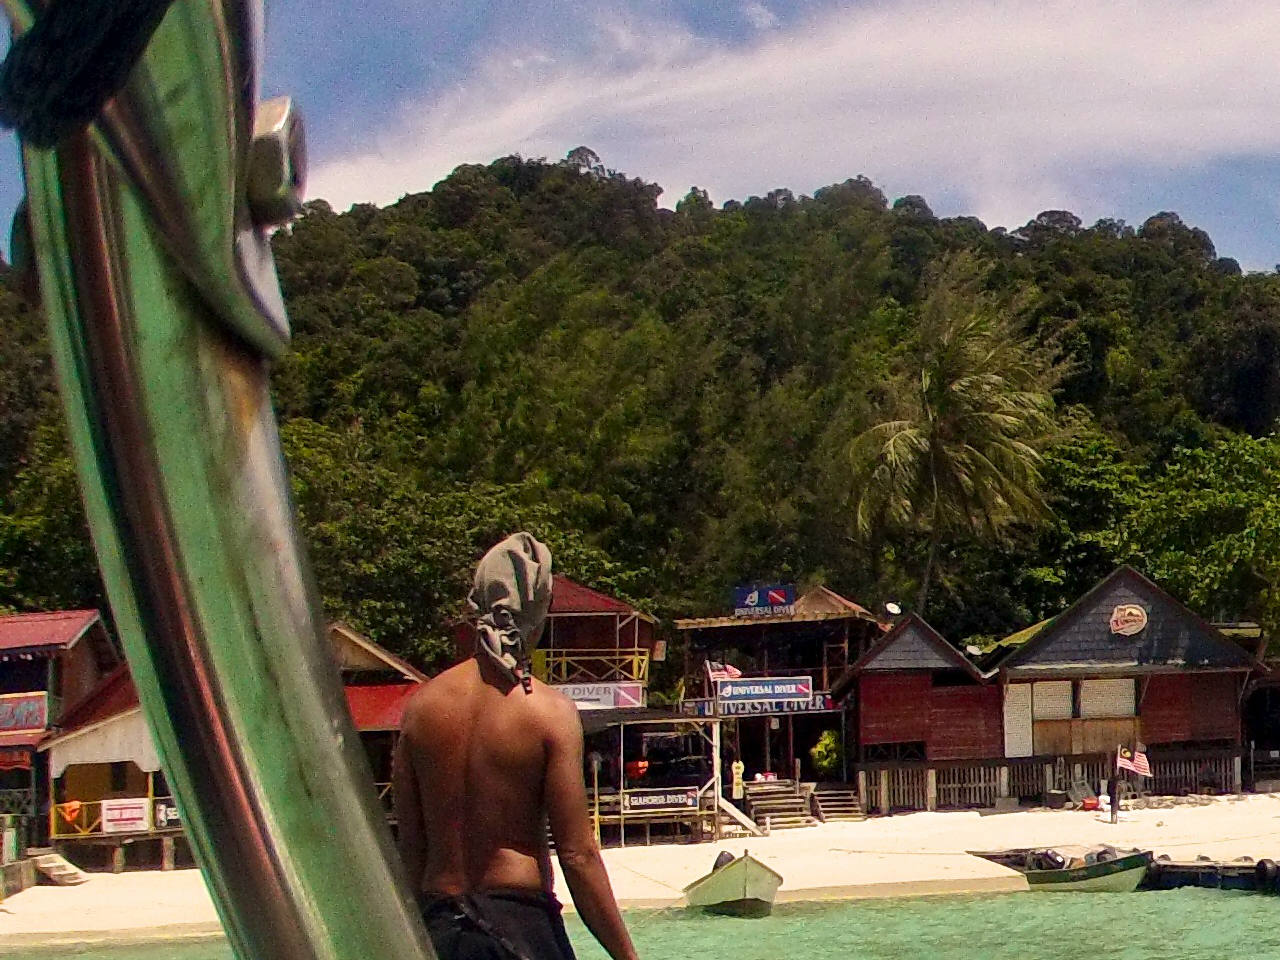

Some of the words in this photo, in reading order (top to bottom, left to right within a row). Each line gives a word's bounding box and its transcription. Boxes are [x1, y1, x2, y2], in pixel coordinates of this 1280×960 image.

[572, 687, 612, 696] DIVER
[733, 685, 772, 695] UNIVERSAL
[775, 684, 796, 694] DIVER
